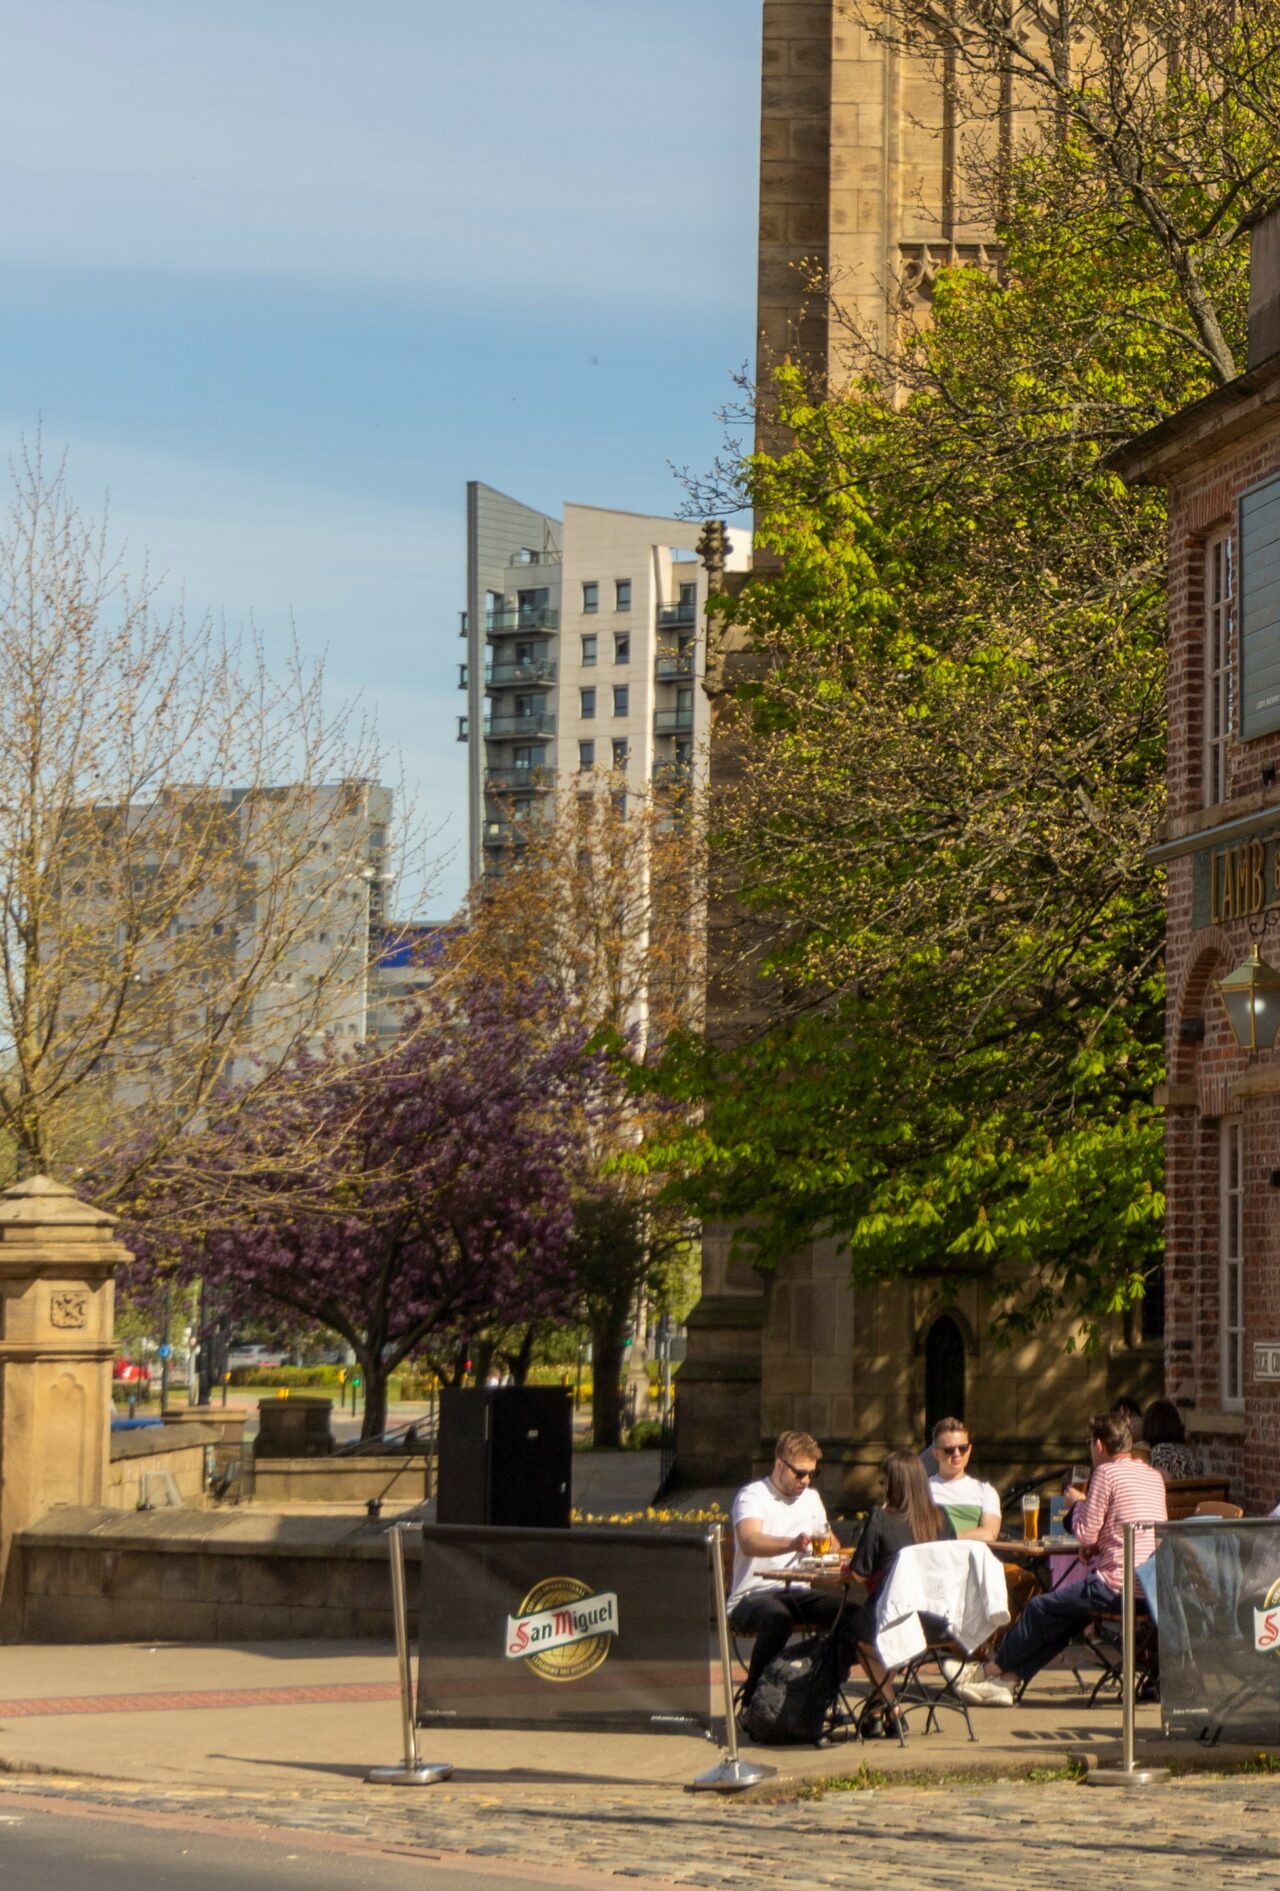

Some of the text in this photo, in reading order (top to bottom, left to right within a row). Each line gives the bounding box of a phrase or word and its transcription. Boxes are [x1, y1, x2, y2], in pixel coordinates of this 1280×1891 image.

[1211, 839, 1265, 924] LAMB
[509, 1620, 552, 1654] San
[550, 1599, 613, 1637] Miguel
